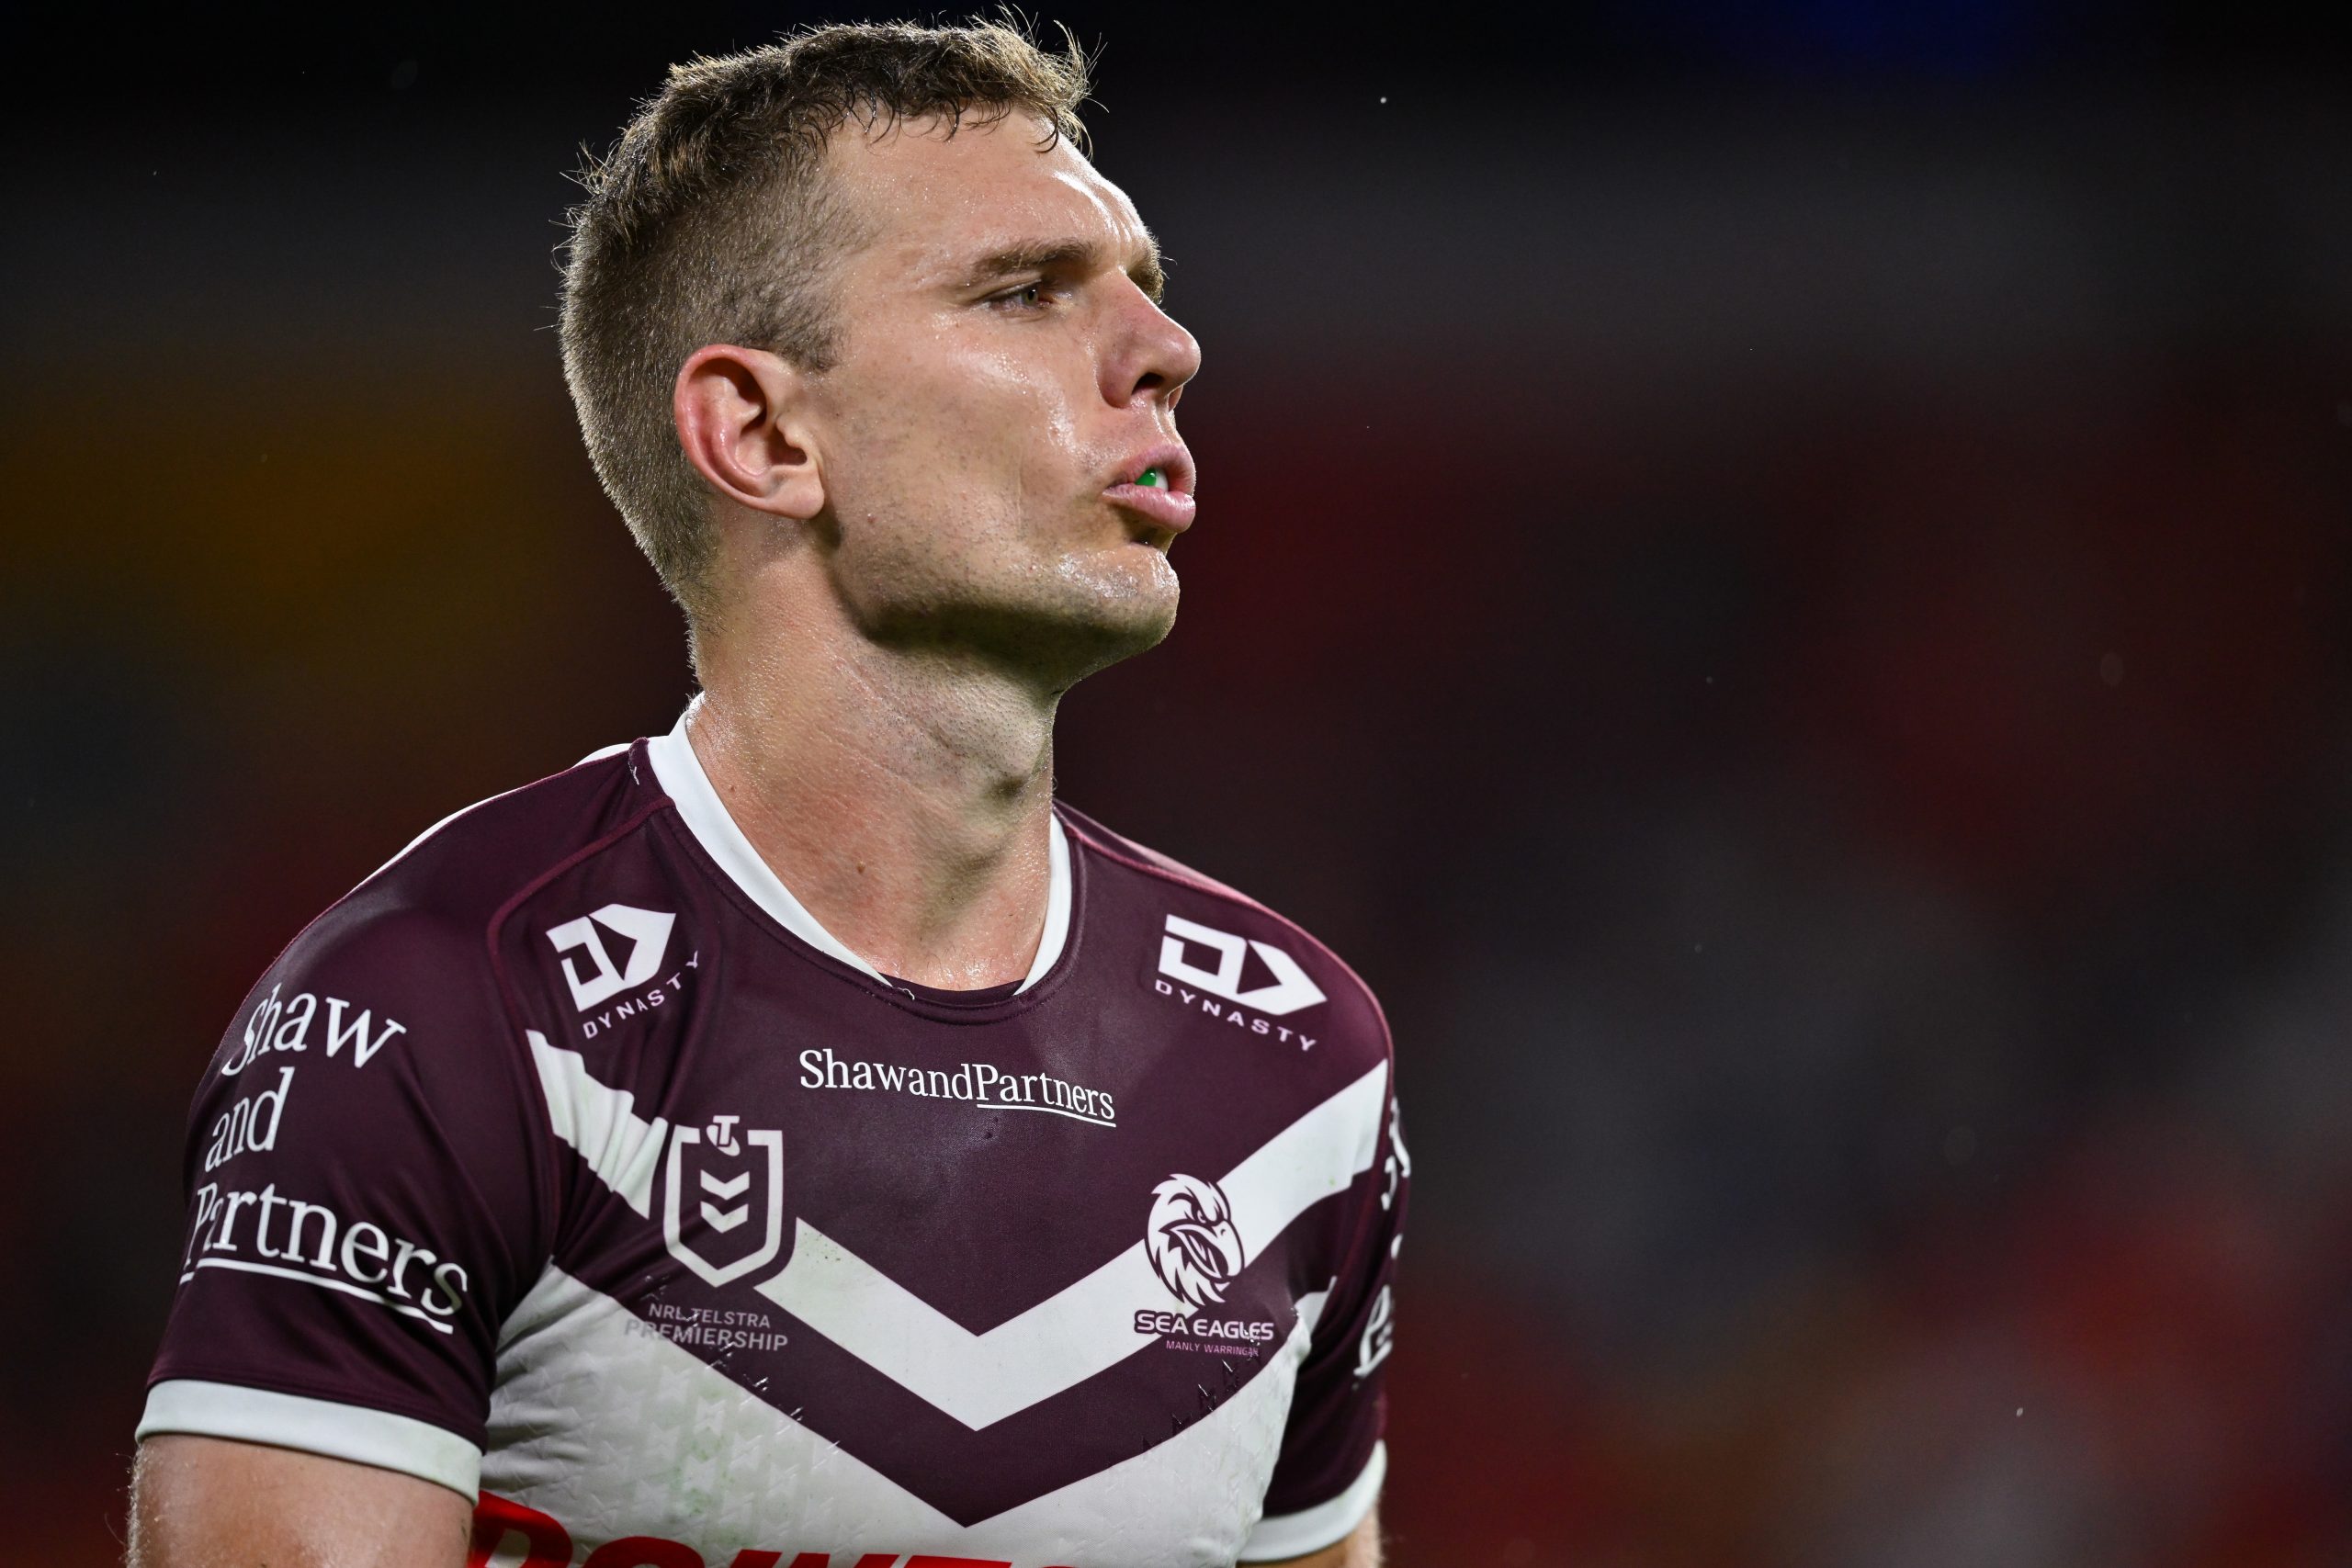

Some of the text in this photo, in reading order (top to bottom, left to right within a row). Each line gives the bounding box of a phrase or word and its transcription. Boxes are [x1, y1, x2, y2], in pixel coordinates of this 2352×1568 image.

[221, 982, 407, 1076] Shaw
[582, 950, 699, 1040] DYNASTY
[1155, 979, 1317, 1051] DYNASTY
[205, 1066, 295, 1172] and
[798, 1048, 1115, 1120] ShawandPartners
[183, 1183, 468, 1316] Partners
[623, 1318, 788, 1351] PREMIERSHIP
[648, 1303, 771, 1328] NRL TELSTRA
[1136, 1313, 1274, 1341] SEA EAGLES
[1165, 1339, 1200, 1352] MANLY
